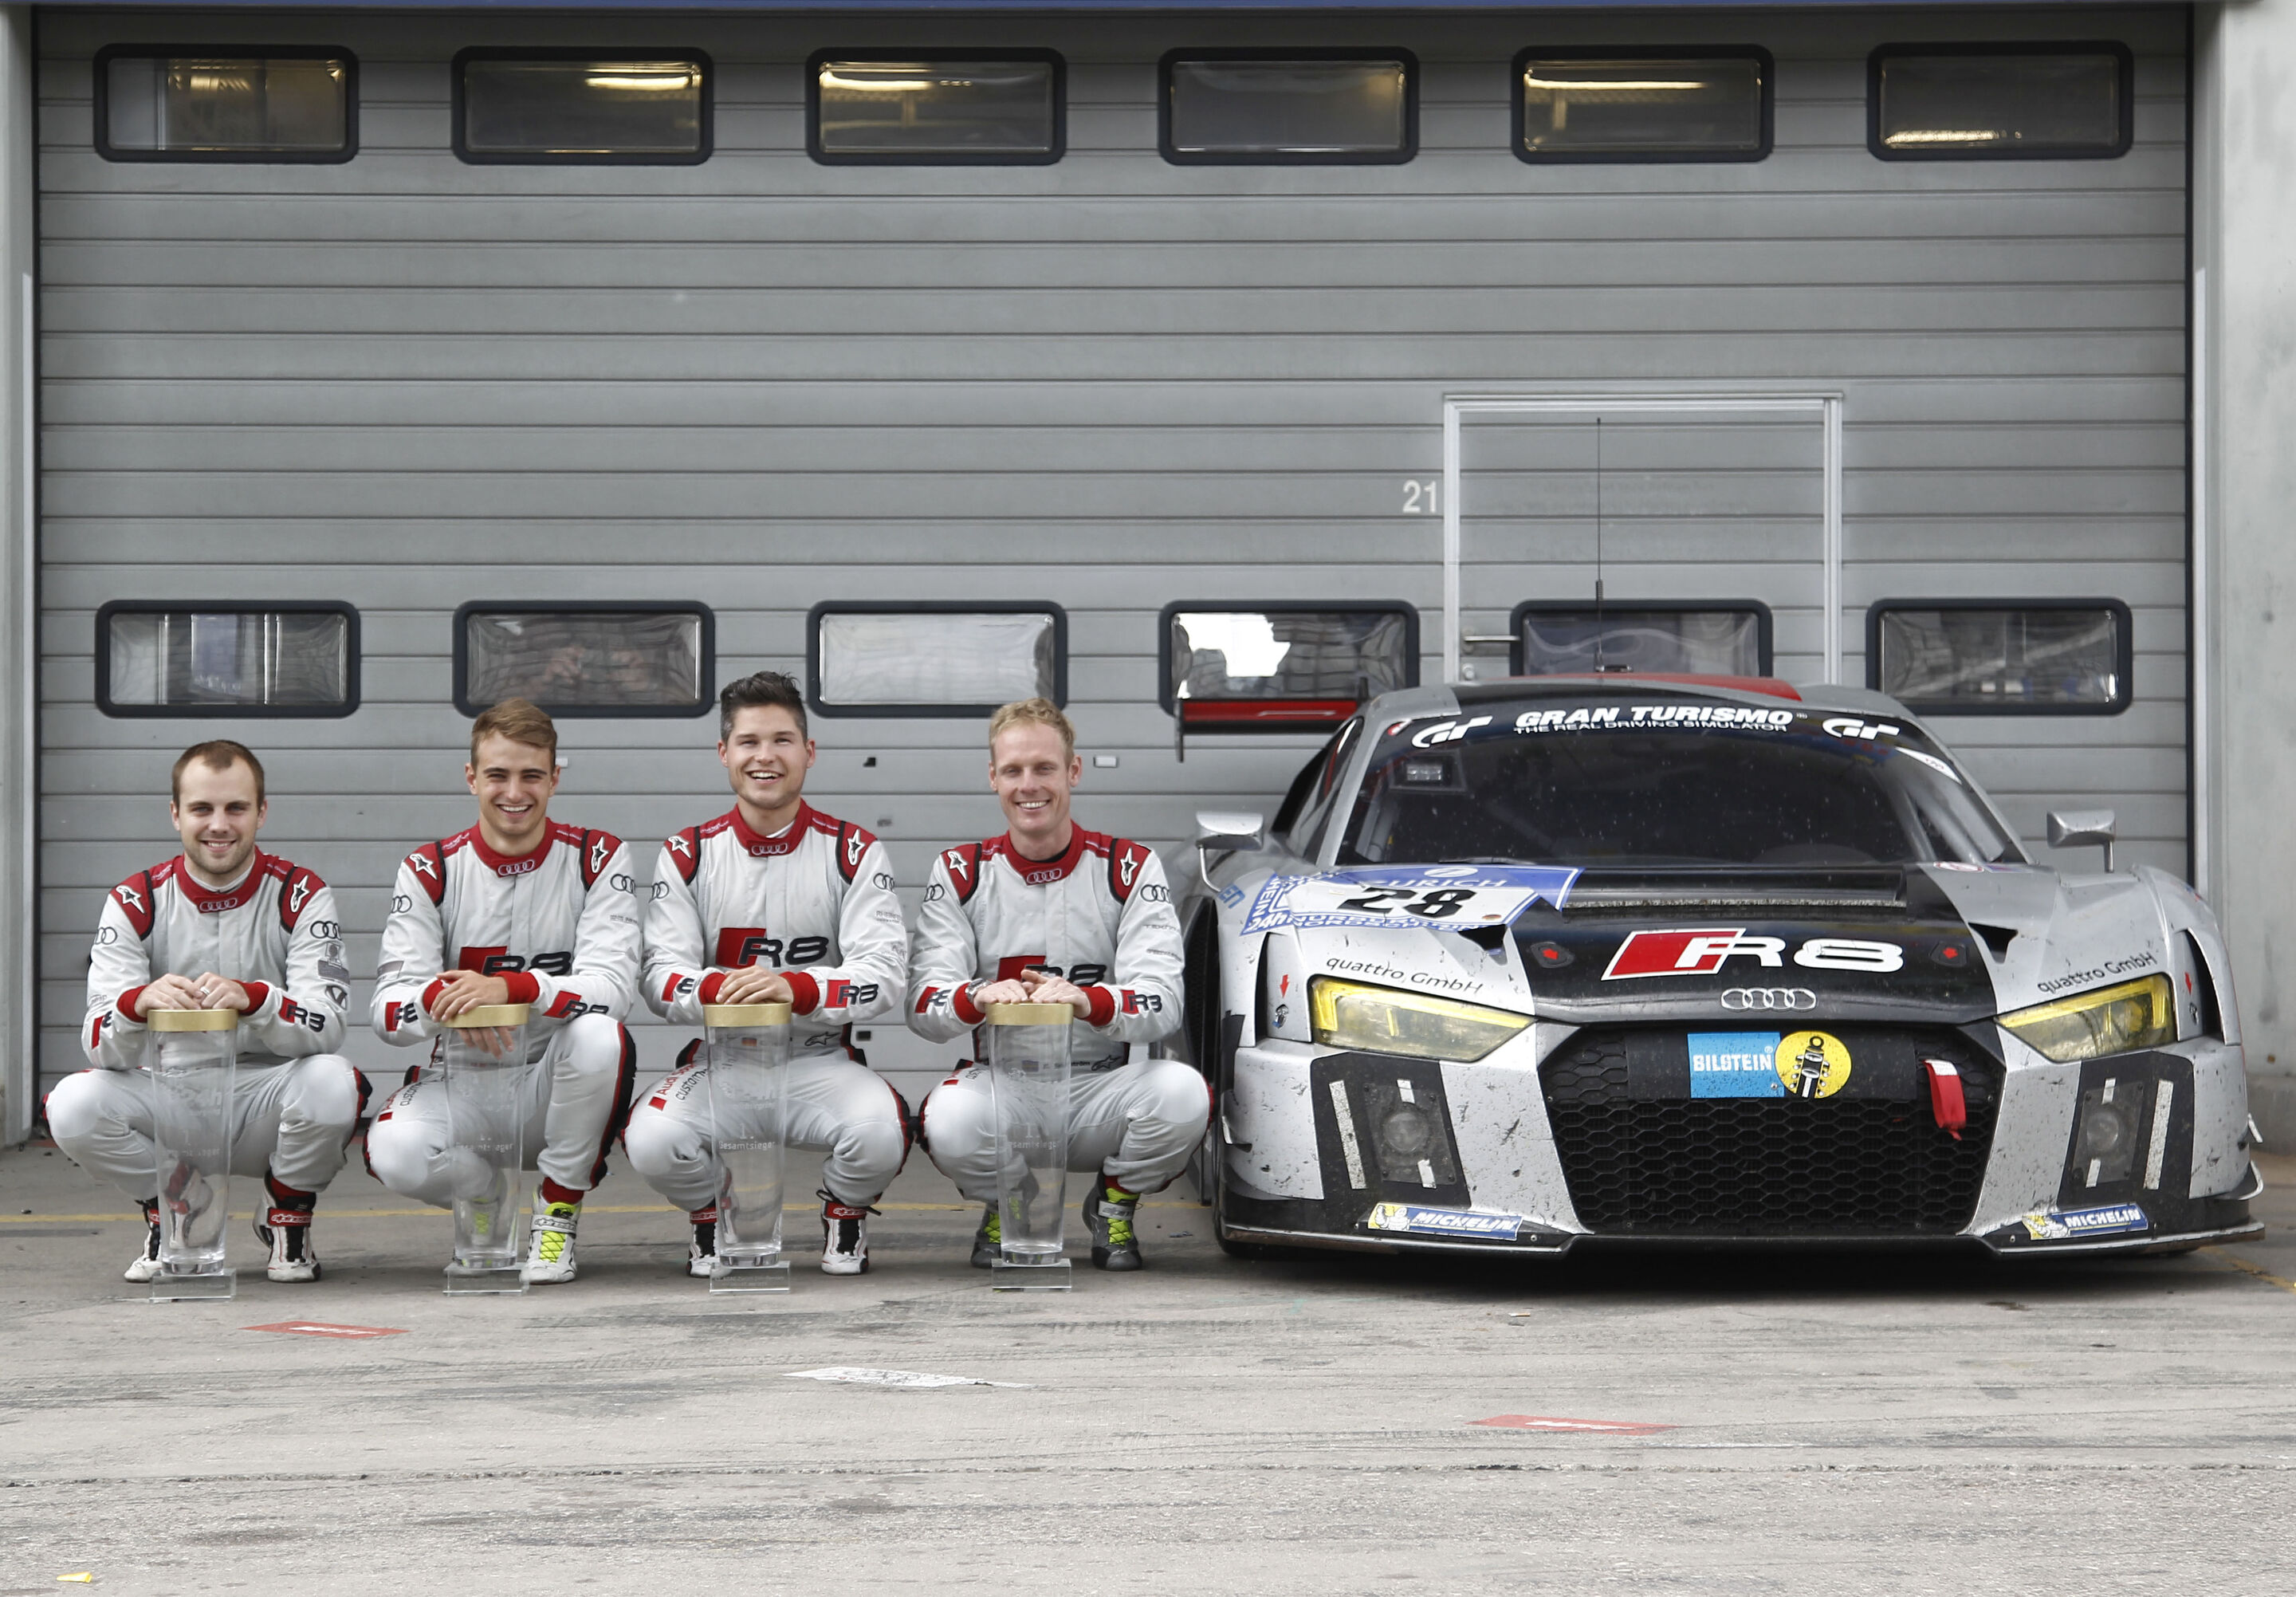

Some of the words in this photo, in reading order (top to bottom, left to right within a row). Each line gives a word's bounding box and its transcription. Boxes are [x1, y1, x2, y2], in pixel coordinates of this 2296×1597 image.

[1402, 479, 1437, 513] 21
[1514, 725, 1550, 735] THE
[1554, 722, 1602, 732] REAL
[1604, 720, 1680, 729] DRIVING
[1685, 721, 1788, 733] SIMULATOR
[1515, 706, 1621, 728] GRAN
[1631, 706, 1794, 726] TURISMO
[1336, 887, 1477, 919] 28
[737, 936, 829, 968] R8
[1674, 935, 1905, 973] R8
[1326, 957, 1404, 979] quattro
[1410, 971, 1484, 993] GmbH
[2037, 968, 2105, 993] quattro
[2104, 951, 2158, 975] GmbH
[1693, 1053, 1772, 1072] BILSTEIN
[1412, 1211, 1518, 1230] MICHELIN
[2063, 1208, 2141, 1228] MICHELIN
